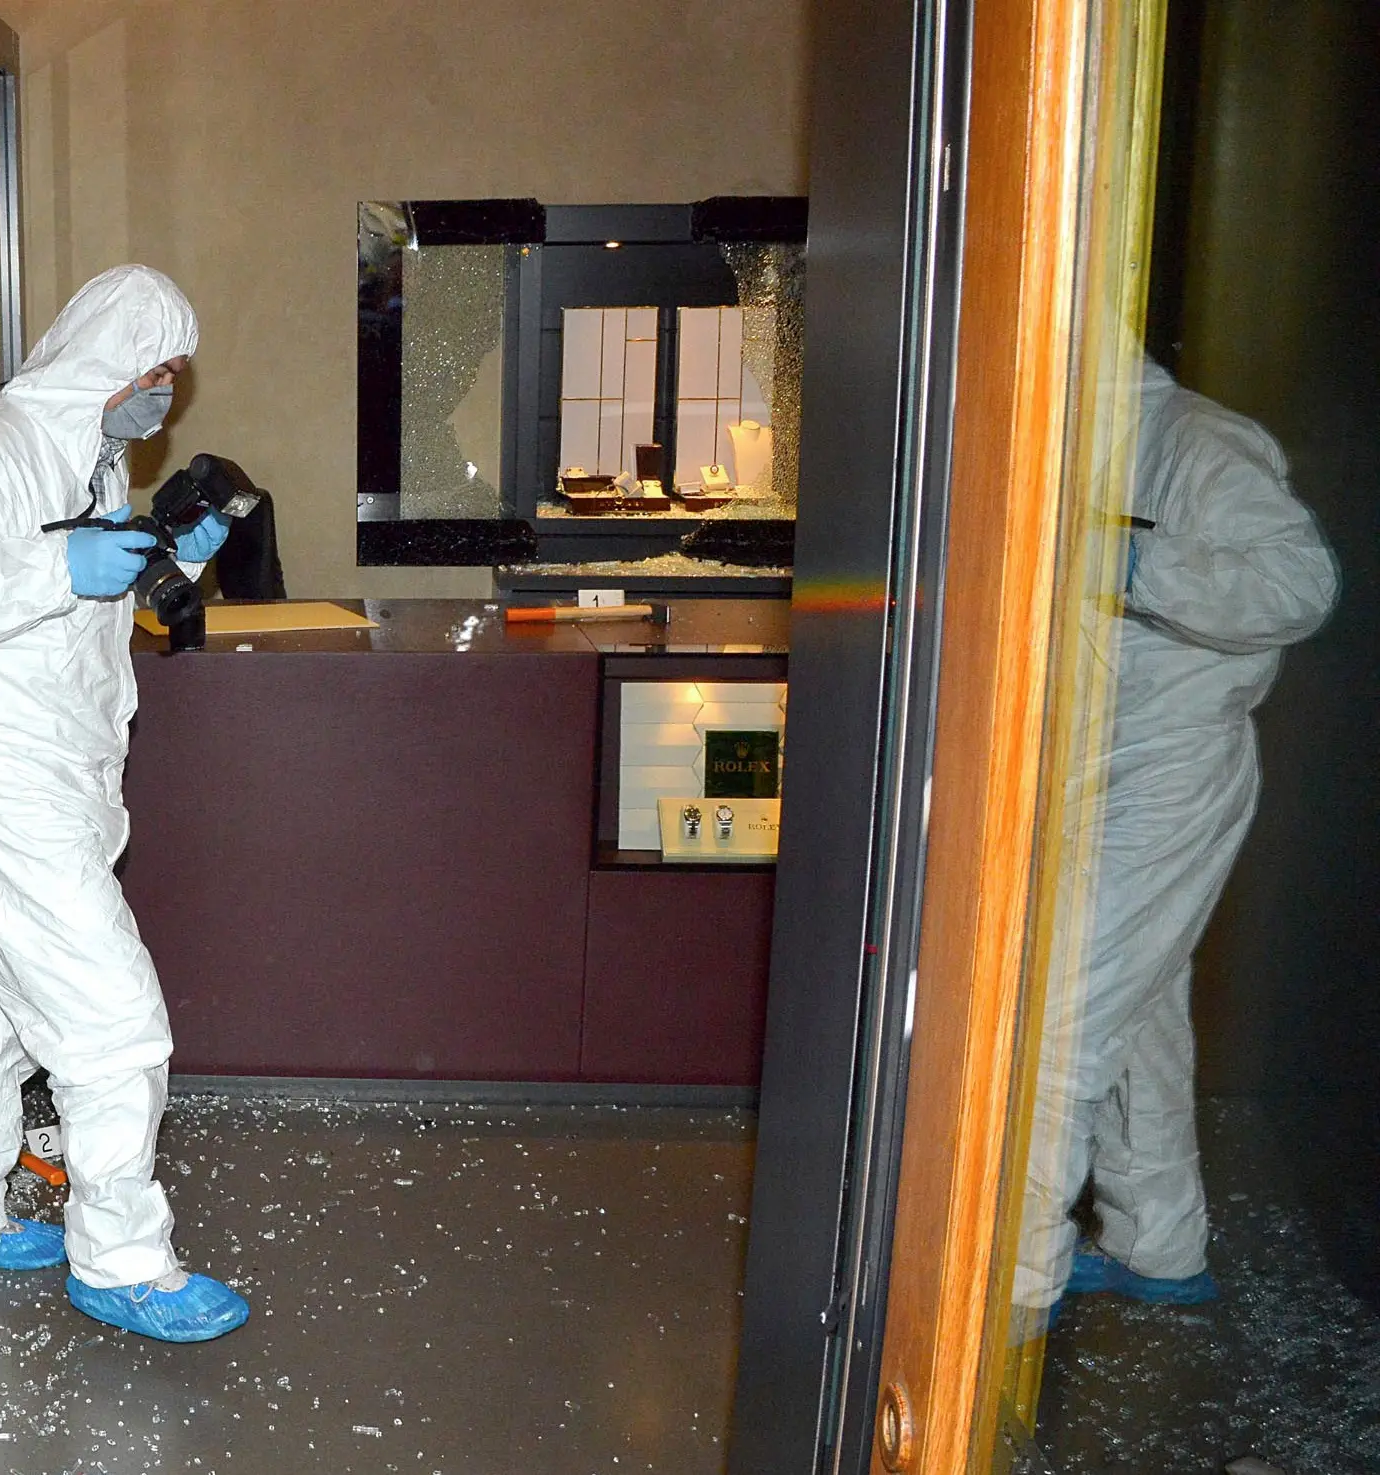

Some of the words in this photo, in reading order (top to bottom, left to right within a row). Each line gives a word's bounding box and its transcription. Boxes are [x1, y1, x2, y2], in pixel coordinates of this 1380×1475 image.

[592, 594, 599, 608] 1
[713, 760, 771, 773] ROLEX
[38, 1133, 53, 1152] 2
